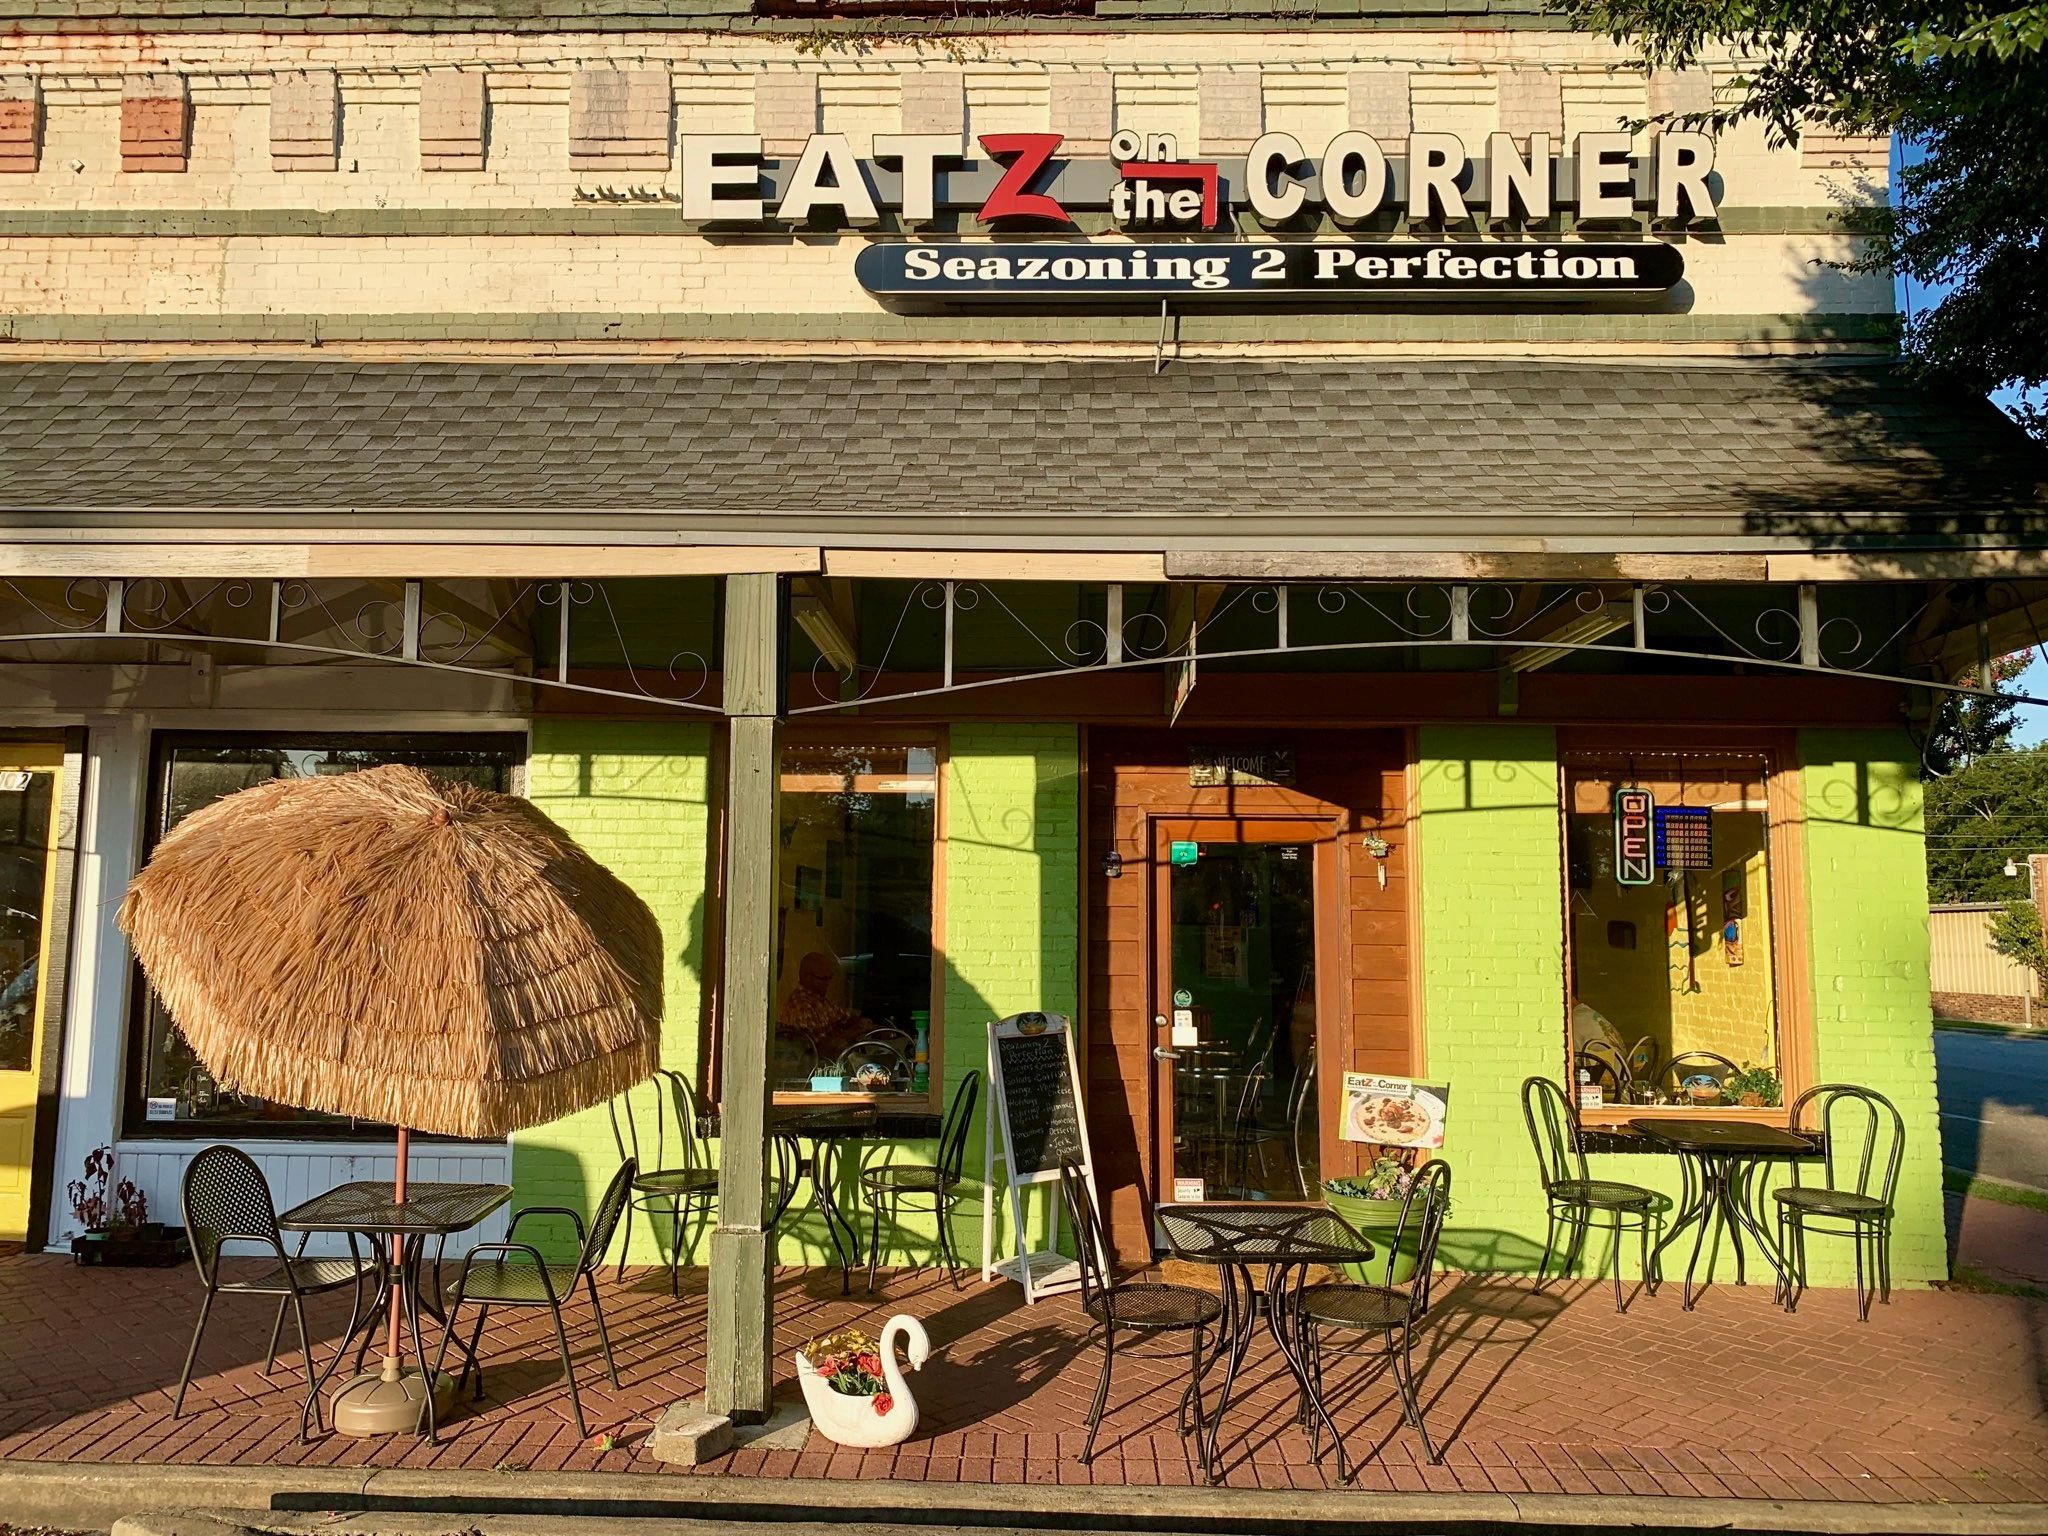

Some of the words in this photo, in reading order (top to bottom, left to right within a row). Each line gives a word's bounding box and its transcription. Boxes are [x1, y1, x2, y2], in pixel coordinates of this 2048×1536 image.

[1109, 129, 1178, 166] on
[681, 133, 1071, 223] EATZ
[1246, 130, 1719, 221] CORNER
[1110, 179, 1200, 222] the
[904, 248, 1231, 289] Seazoning
[1251, 248, 1287, 280] 2
[1314, 248, 1640, 281] Perfection
[1213, 755, 1267, 775] WELCOME
[1623, 795, 1647, 879] OPEN
[1043, 1038, 1053, 1048] 2
[1347, 1076, 1374, 1087] EatZ
[1378, 1079, 1409, 1090] Corner
[1053, 1137, 1073, 1148] Jerk
